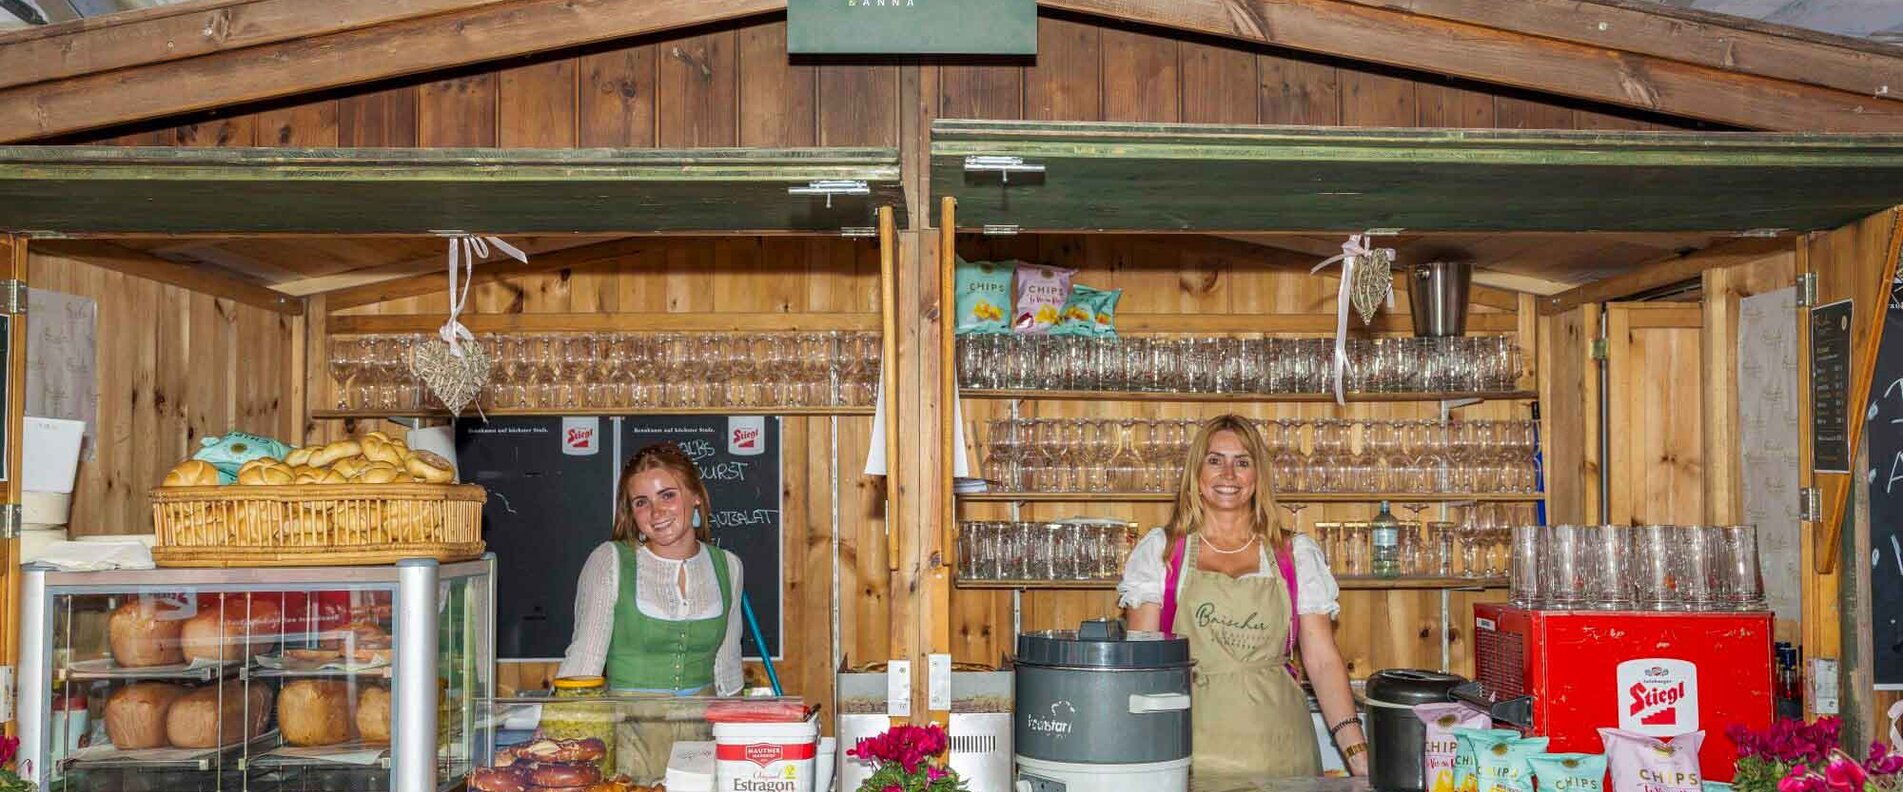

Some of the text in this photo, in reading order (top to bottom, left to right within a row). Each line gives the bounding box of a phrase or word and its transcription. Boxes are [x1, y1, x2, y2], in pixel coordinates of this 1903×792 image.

[969, 282, 1005, 293] CHIPS
[1028, 285, 1064, 296] CHIPS
[567, 428, 593, 444] Stiegl
[733, 428, 759, 444] Stiegl
[1630, 681, 1685, 717] Stiegl
[1426, 741, 1457, 753] HIP
[1455, 755, 1474, 766] CHI
[1555, 776, 1598, 791] CHIPS
[1639, 768, 1699, 785] CHIPS
[733, 778, 796, 792] Estragon
